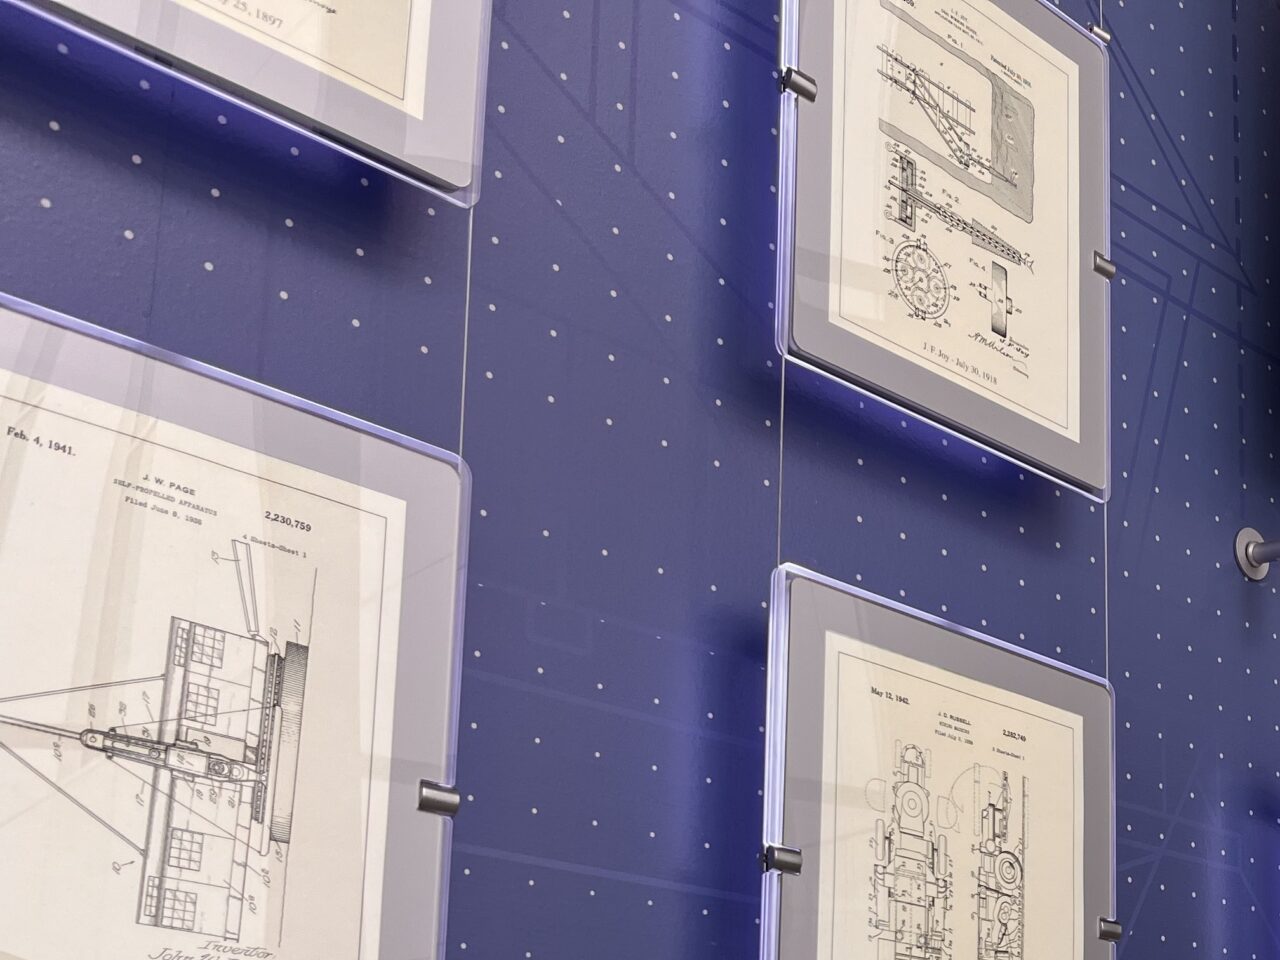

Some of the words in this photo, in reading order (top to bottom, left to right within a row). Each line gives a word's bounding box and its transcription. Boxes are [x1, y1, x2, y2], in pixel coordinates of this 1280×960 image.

[256, 8, 283, 28] 1897
[938, 349, 949, 362] Joy
[956, 358, 969, 372] July
[7, 426, 29, 442] Feb.
[33, 436, 43, 447] 4,
[48, 440, 76, 456] 1941.
[155, 476, 165, 486] W.
[169, 481, 196, 496] PAGE
[113, 478, 175, 502] SELF-PROPELLED
[178, 499, 218, 516] APPARATUS
[125, 496, 148, 508] Filed
[151, 504, 169, 515] June
[264, 511, 312, 532] 2,230,759
[871, 686, 883, 697] May
[885, 692, 893, 701] 12,
